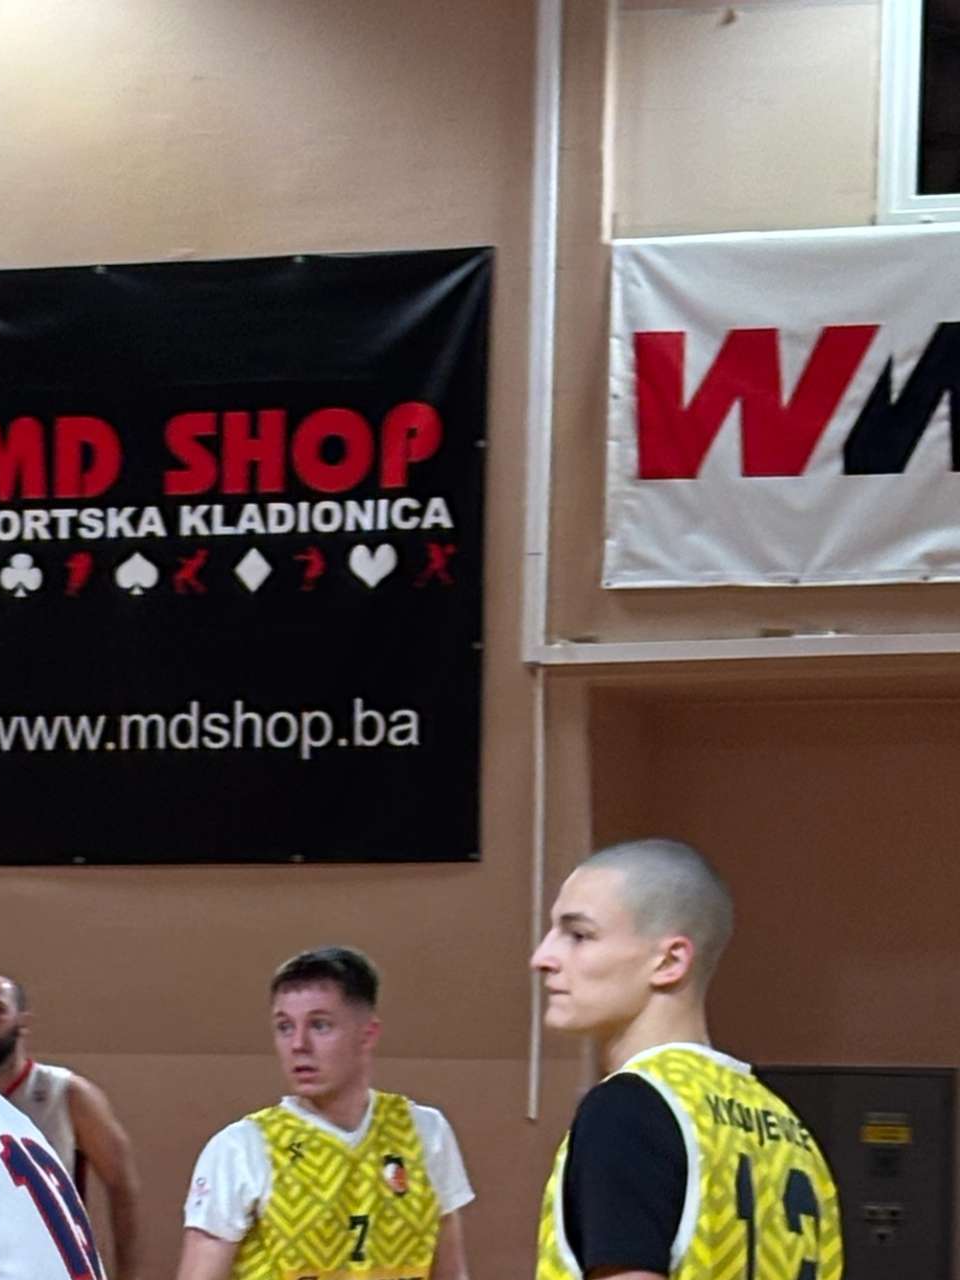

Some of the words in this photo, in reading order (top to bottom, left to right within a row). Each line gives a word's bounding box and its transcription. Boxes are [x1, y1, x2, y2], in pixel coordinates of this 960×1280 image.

[163, 401, 443, 496] SHOP
[179, 497, 454, 537] KLADIONICA
[349, 1214, 369, 1262] 7
